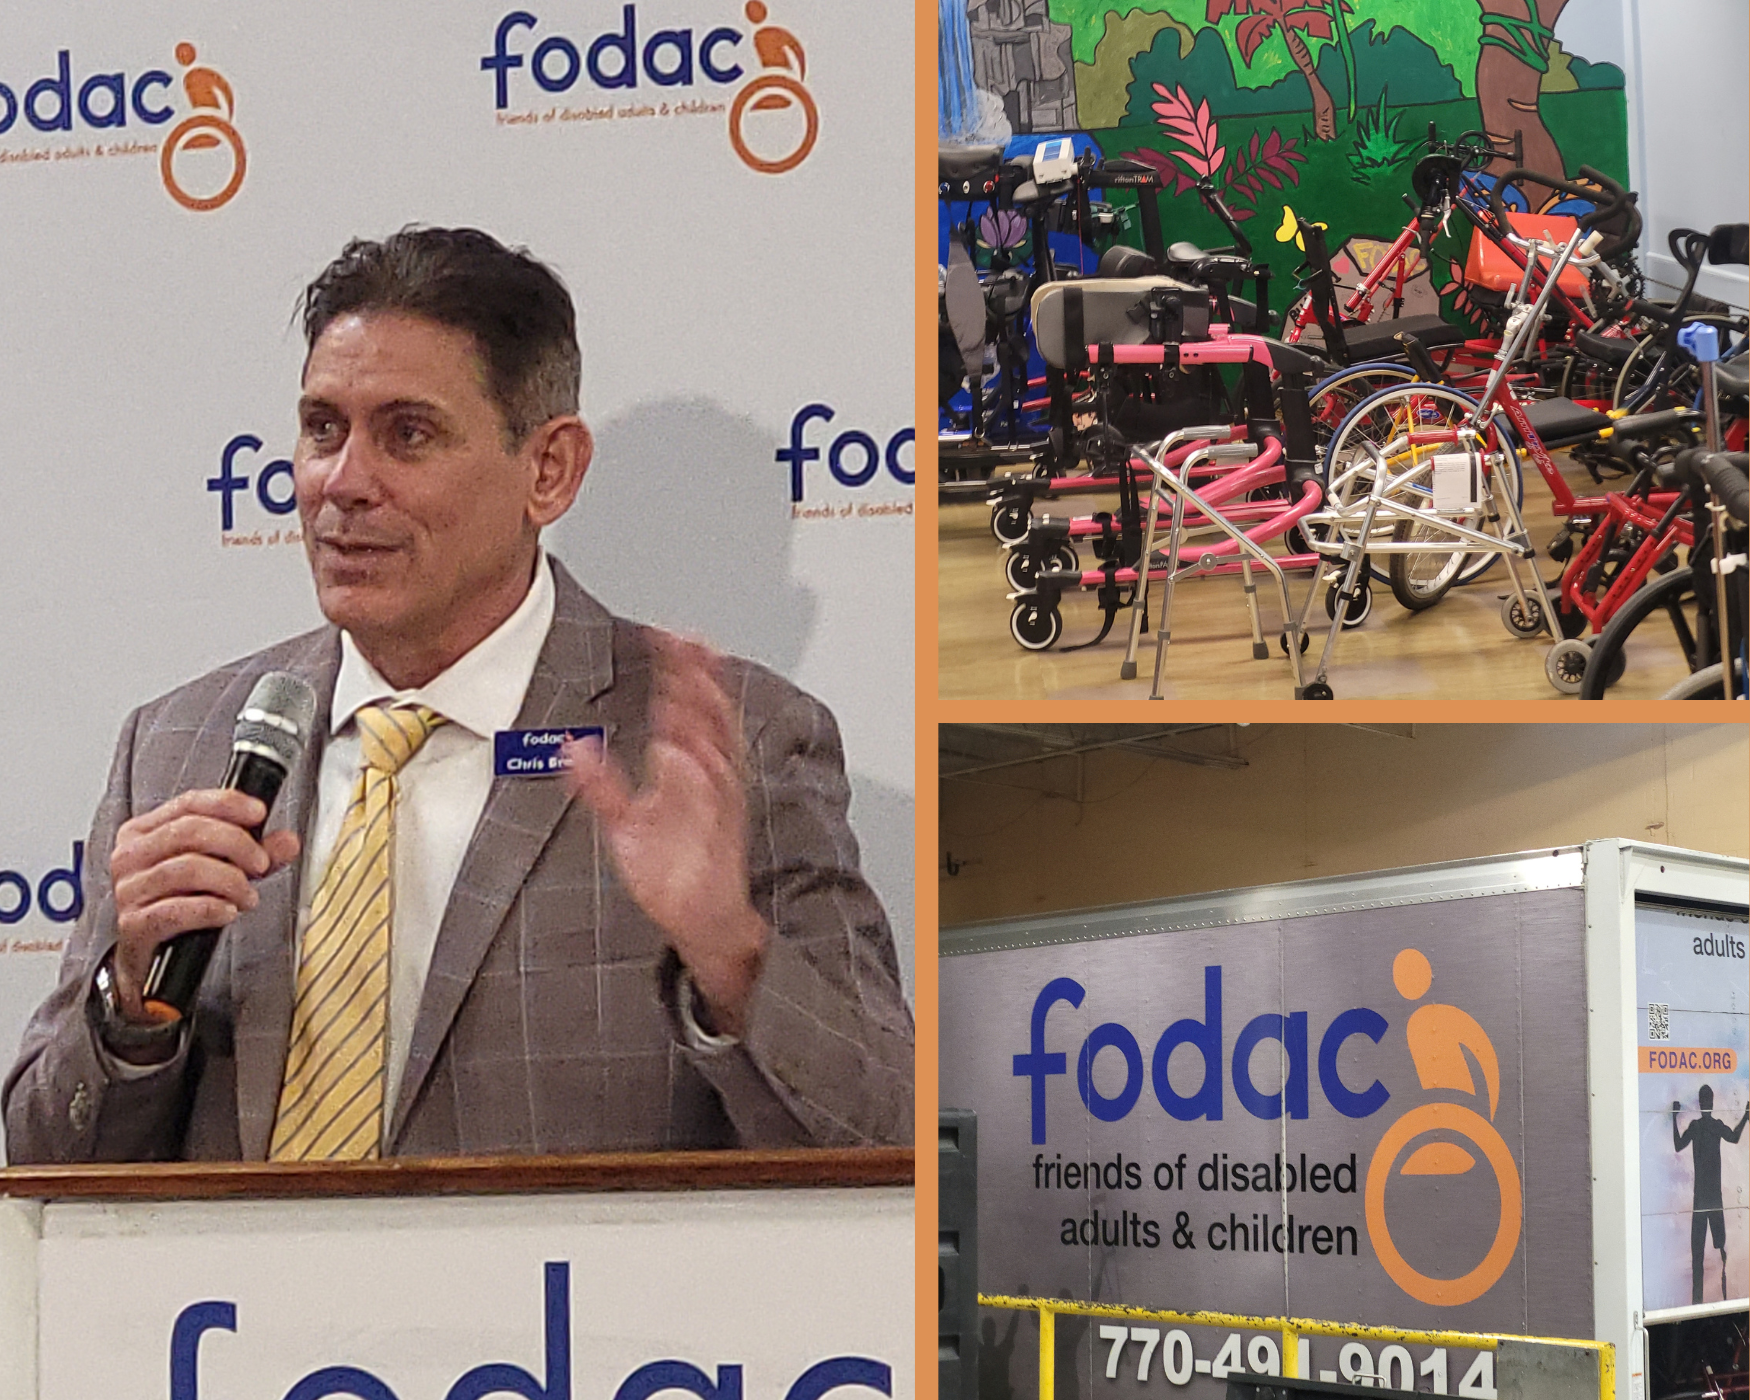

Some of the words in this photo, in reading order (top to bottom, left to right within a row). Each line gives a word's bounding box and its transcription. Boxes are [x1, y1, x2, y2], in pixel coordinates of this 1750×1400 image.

[480, 4, 744, 109] fodac
[1693, 932, 1746, 959] adults
[1013, 965, 1391, 1144] fodac
[1649, 1051, 1731, 1069] FODAC.ORG
[1033, 1153, 1142, 1190] friends
[1154, 1153, 1187, 1191] of
[1198, 1153, 1357, 1194] disabled
[1060, 1209, 1161, 1248] adults
[1172, 1211, 1196, 1250] &
[1208, 1213, 1358, 1256] children
